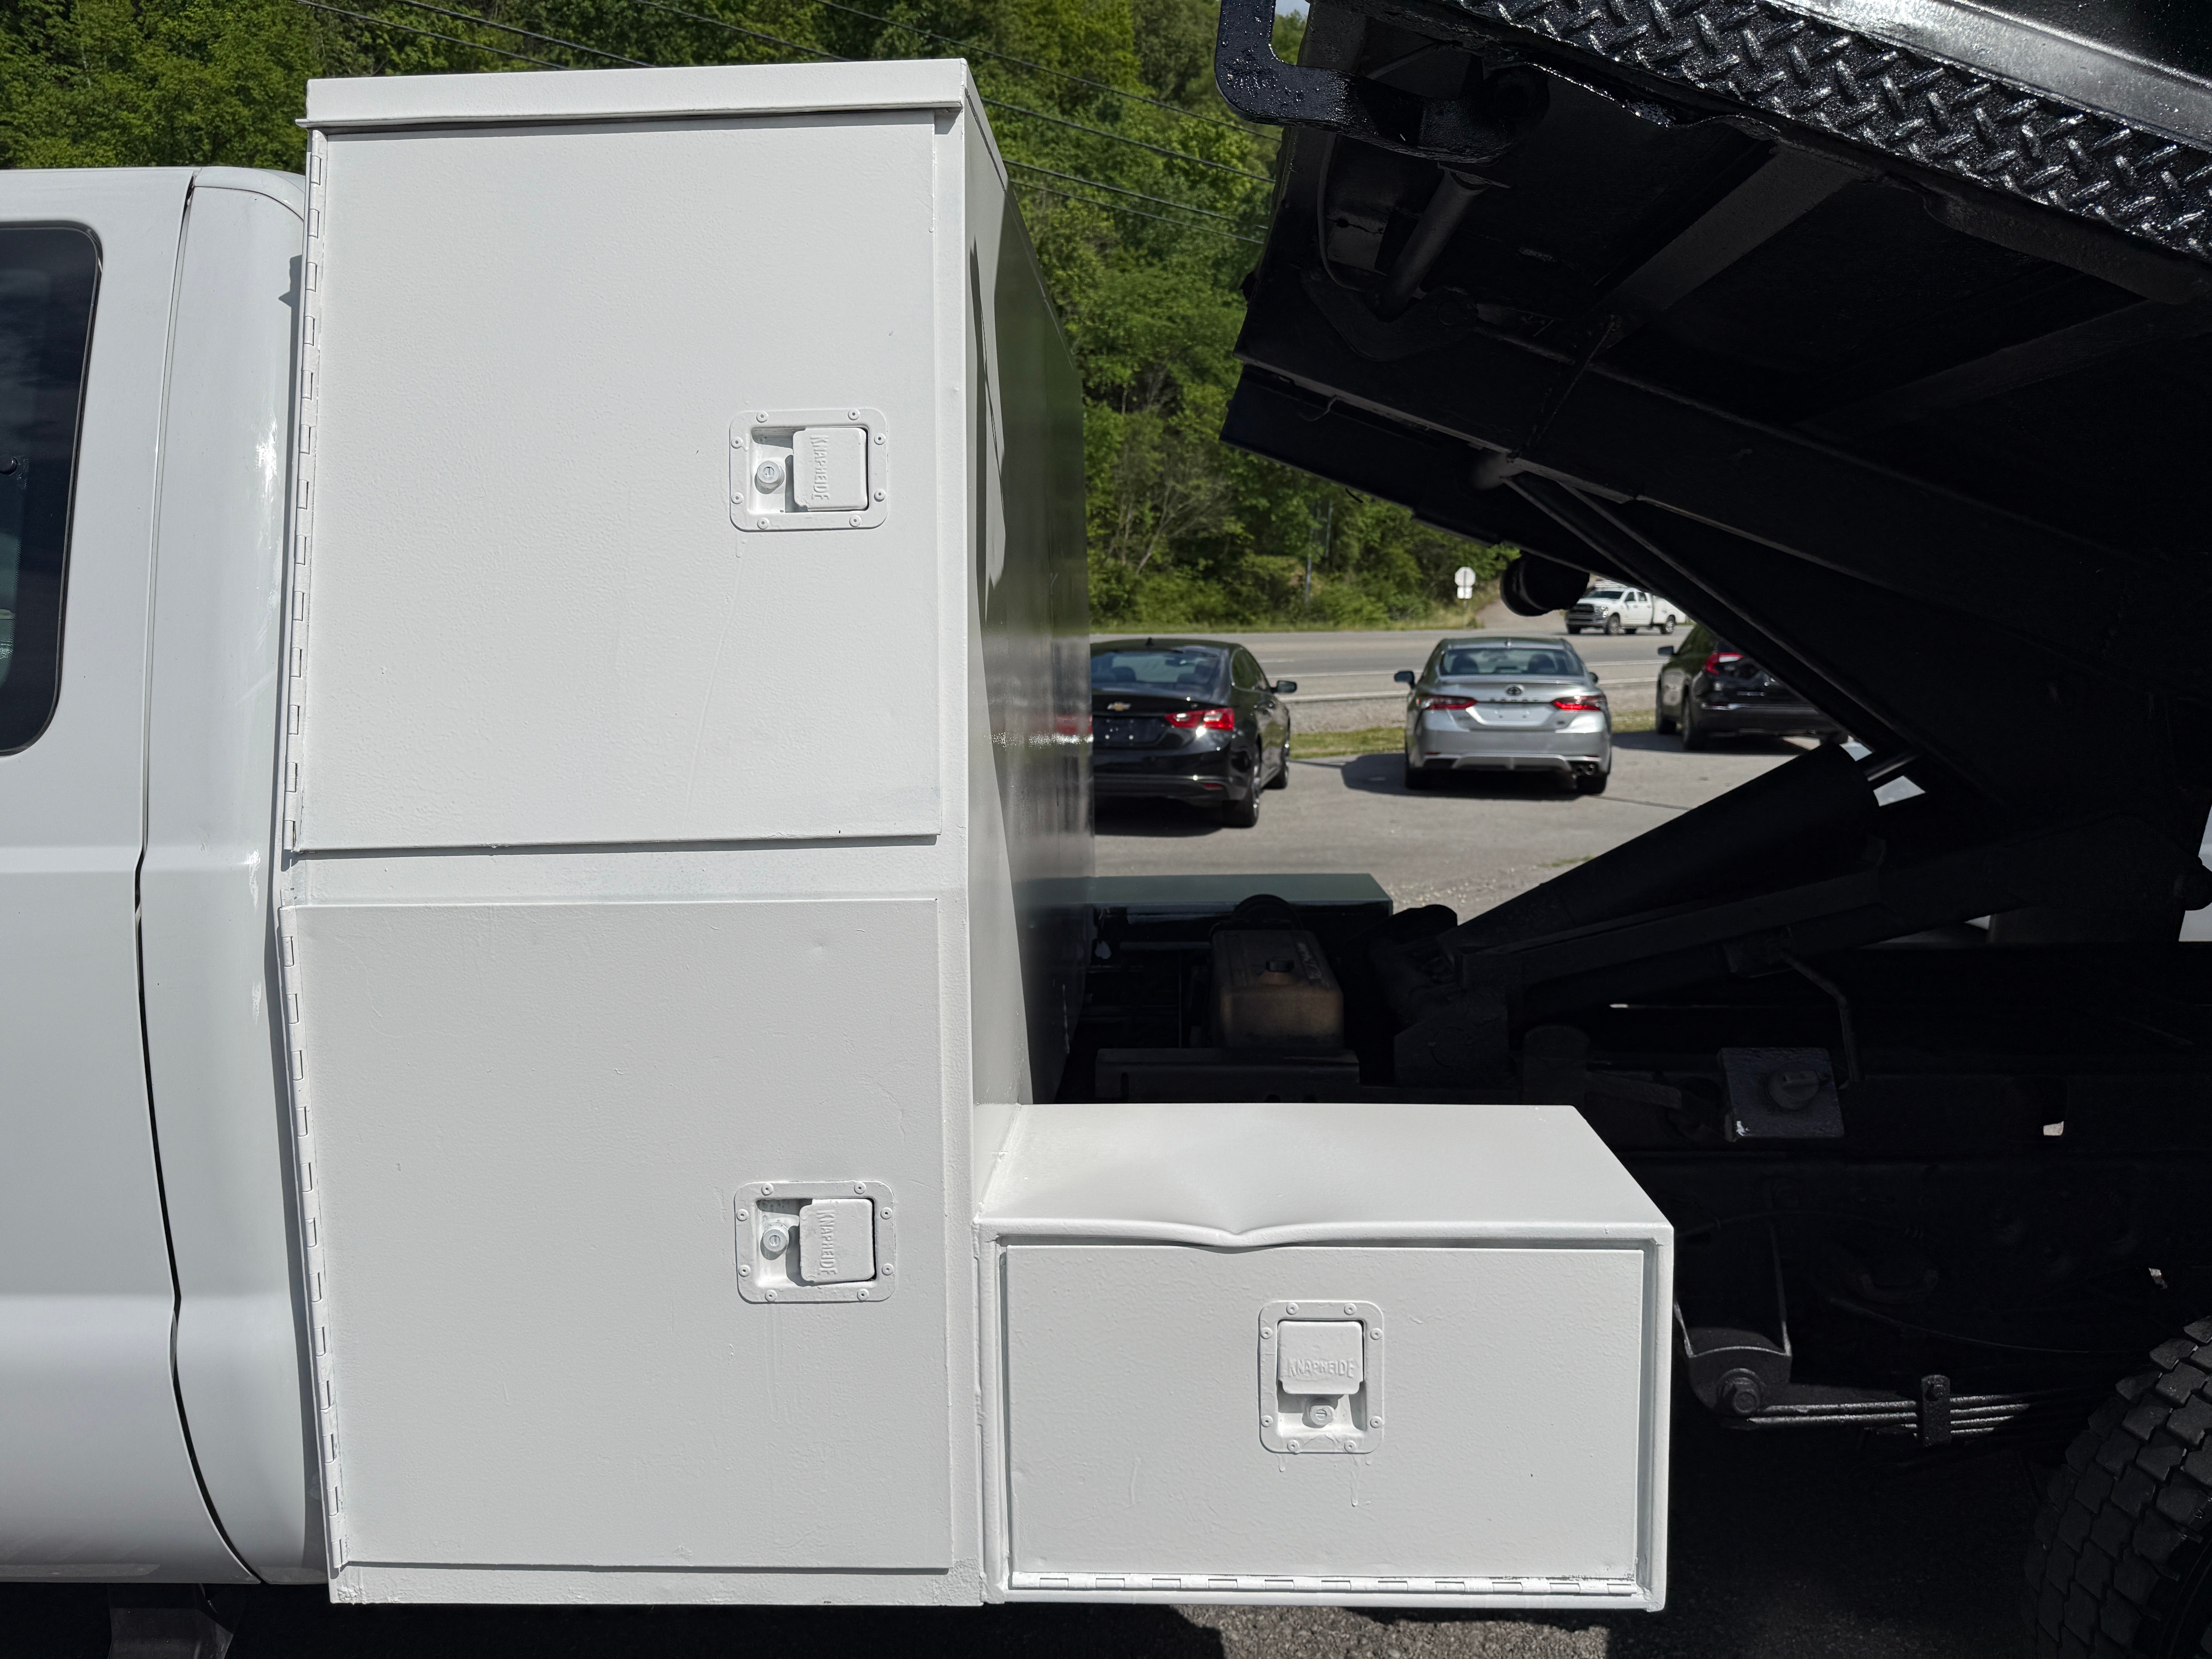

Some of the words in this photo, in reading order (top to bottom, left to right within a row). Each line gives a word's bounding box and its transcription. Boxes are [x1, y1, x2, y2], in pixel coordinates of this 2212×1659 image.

[810, 435, 830, 500] KNAPHEIDE
[816, 1210, 837, 1275] KNAPHEIDE
[1288, 1357, 1355, 1378] KNAPHEIDE
